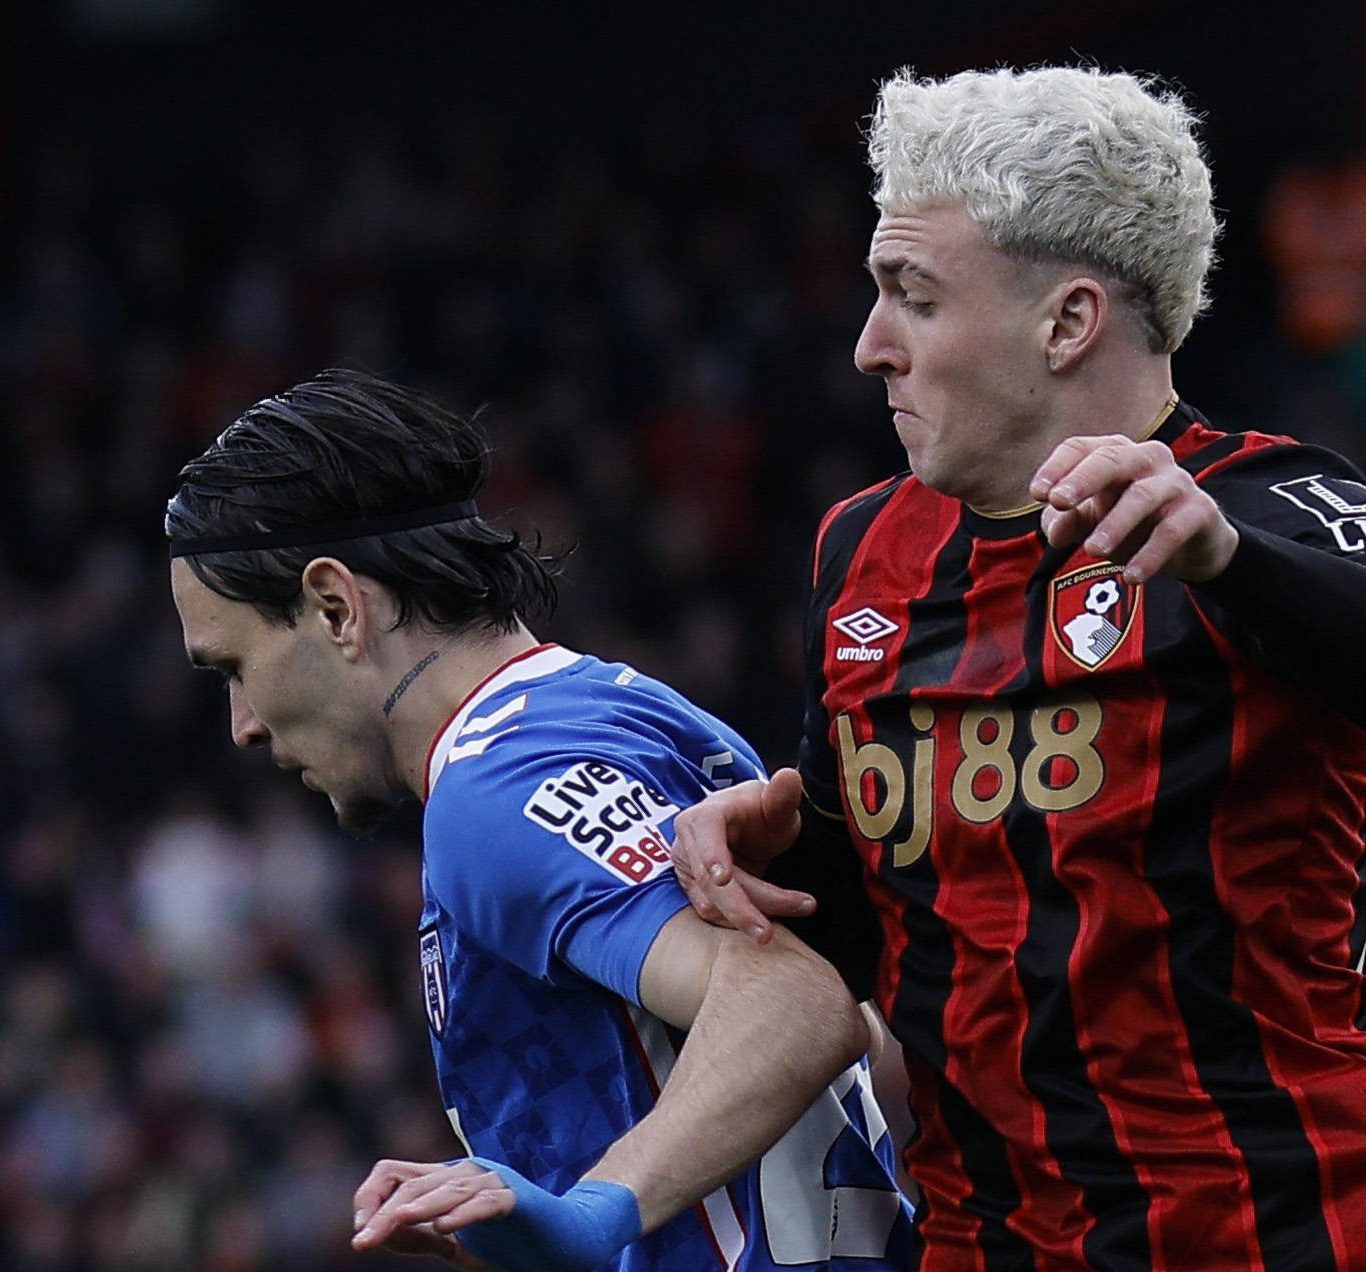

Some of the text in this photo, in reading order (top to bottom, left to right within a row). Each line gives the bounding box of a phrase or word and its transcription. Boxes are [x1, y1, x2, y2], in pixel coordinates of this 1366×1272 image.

[1073, 565, 1125, 584] BOURNEMOU
[836, 645, 884, 661] umbro
[529, 762, 620, 827] Live
[837, 693, 1106, 868] bj88
